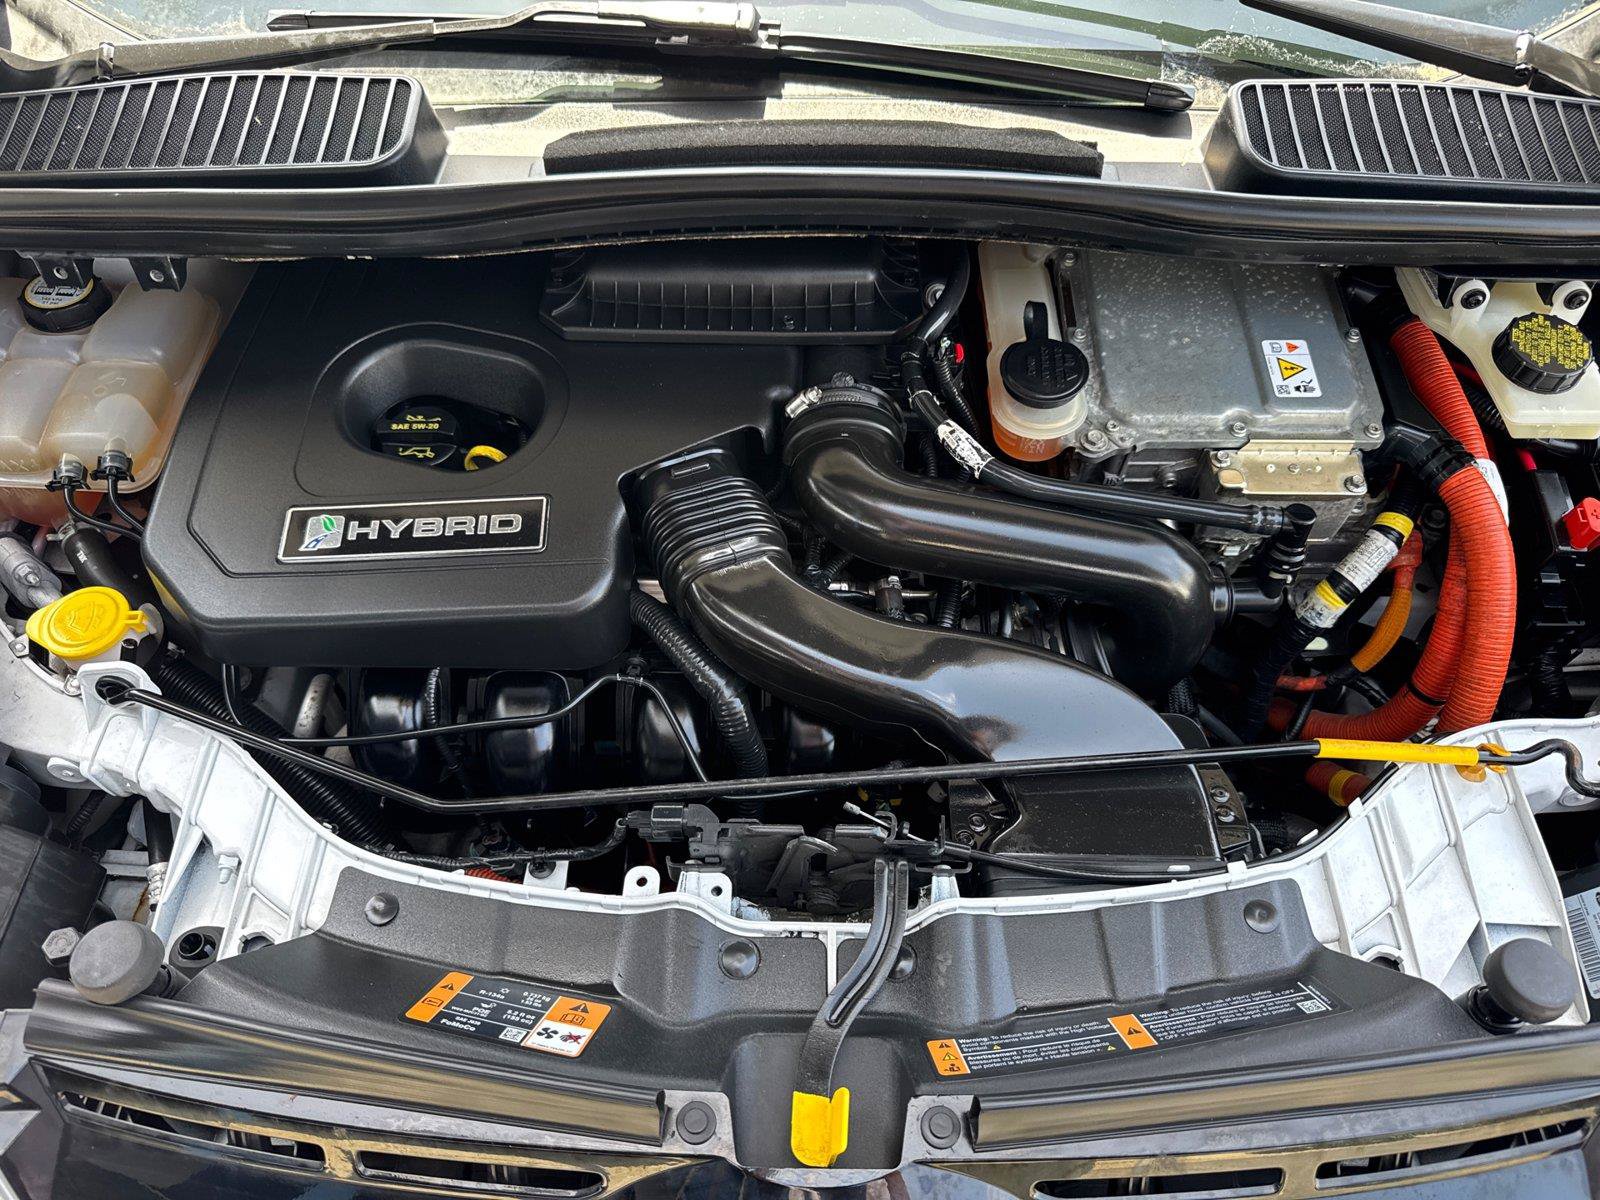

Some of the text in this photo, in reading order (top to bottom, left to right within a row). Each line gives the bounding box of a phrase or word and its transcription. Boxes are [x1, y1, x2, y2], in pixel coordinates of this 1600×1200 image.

[347, 514, 522, 540] HYBRID
[479, 989, 505, 999] R-134a
[440, 1018, 476, 1031] FoMoCo
[1149, 1018, 1196, 1028] Avertissement
[1183, 1017, 1219, 1026] intervention
[1176, 1022, 1215, 1032] commutateur
[979, 1036, 1018, 1045] components
[967, 1049, 1016, 1060] Avertissement
[968, 1056, 1001, 1065] blessures
[1070, 1042, 1109, 1051] composants
[1015, 1056, 1043, 1064] symbole
